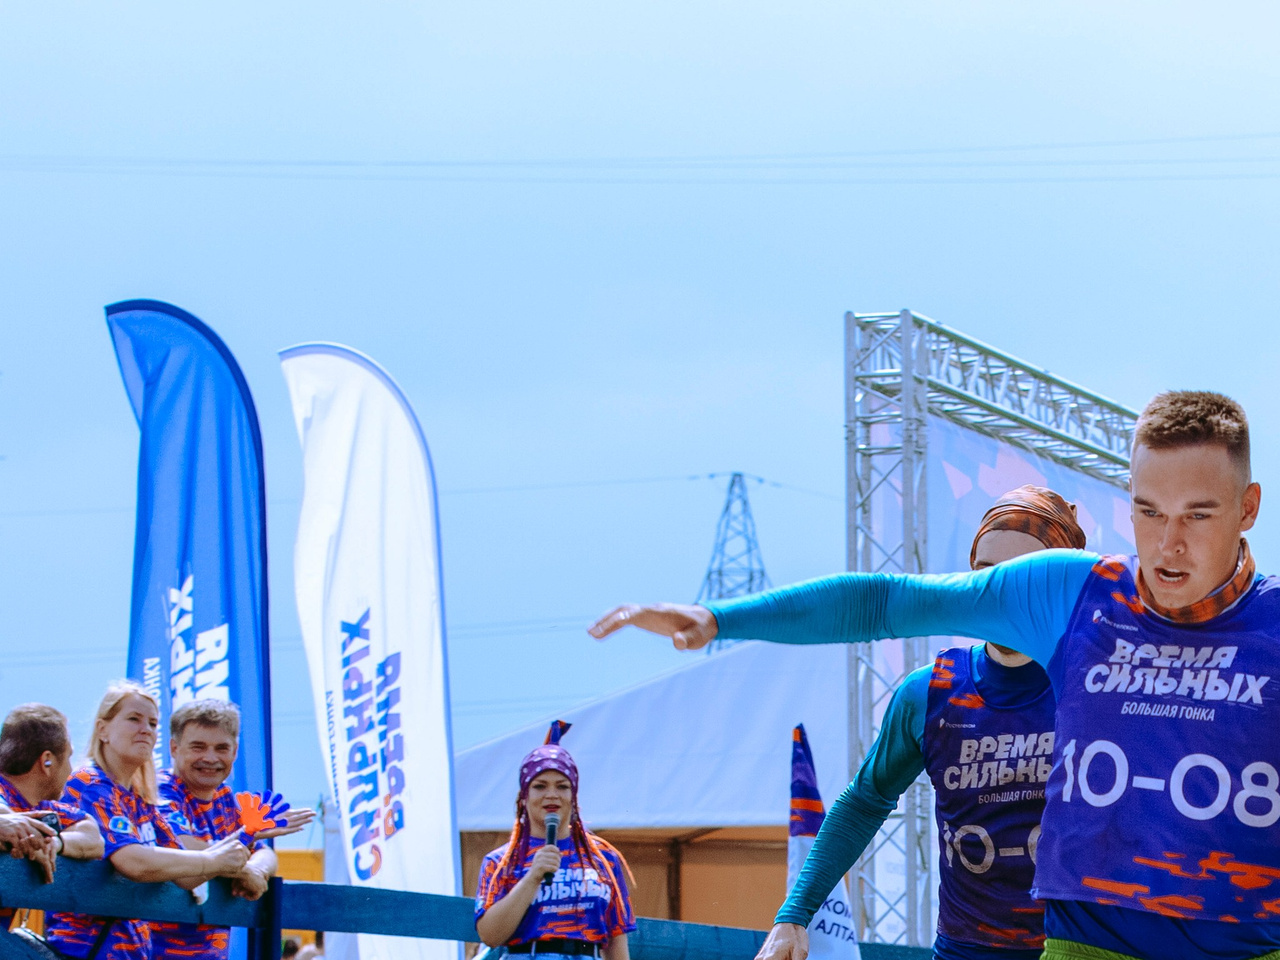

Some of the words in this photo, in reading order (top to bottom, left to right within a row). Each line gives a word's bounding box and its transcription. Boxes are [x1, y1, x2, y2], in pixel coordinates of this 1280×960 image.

[1109, 638, 1239, 670] ВРЕМЯ
[1084, 663, 1271, 705] СИЛЬНЫХ
[1121, 701, 1177, 719] БОЛЬШАЯ
[1179, 704, 1216, 722] ГОНКА
[960, 732, 1056, 764] ВРЕМЯ
[979, 791, 1020, 804] БОЛЬШАЯ
[1021, 789, 1046, 801] ГОНК
